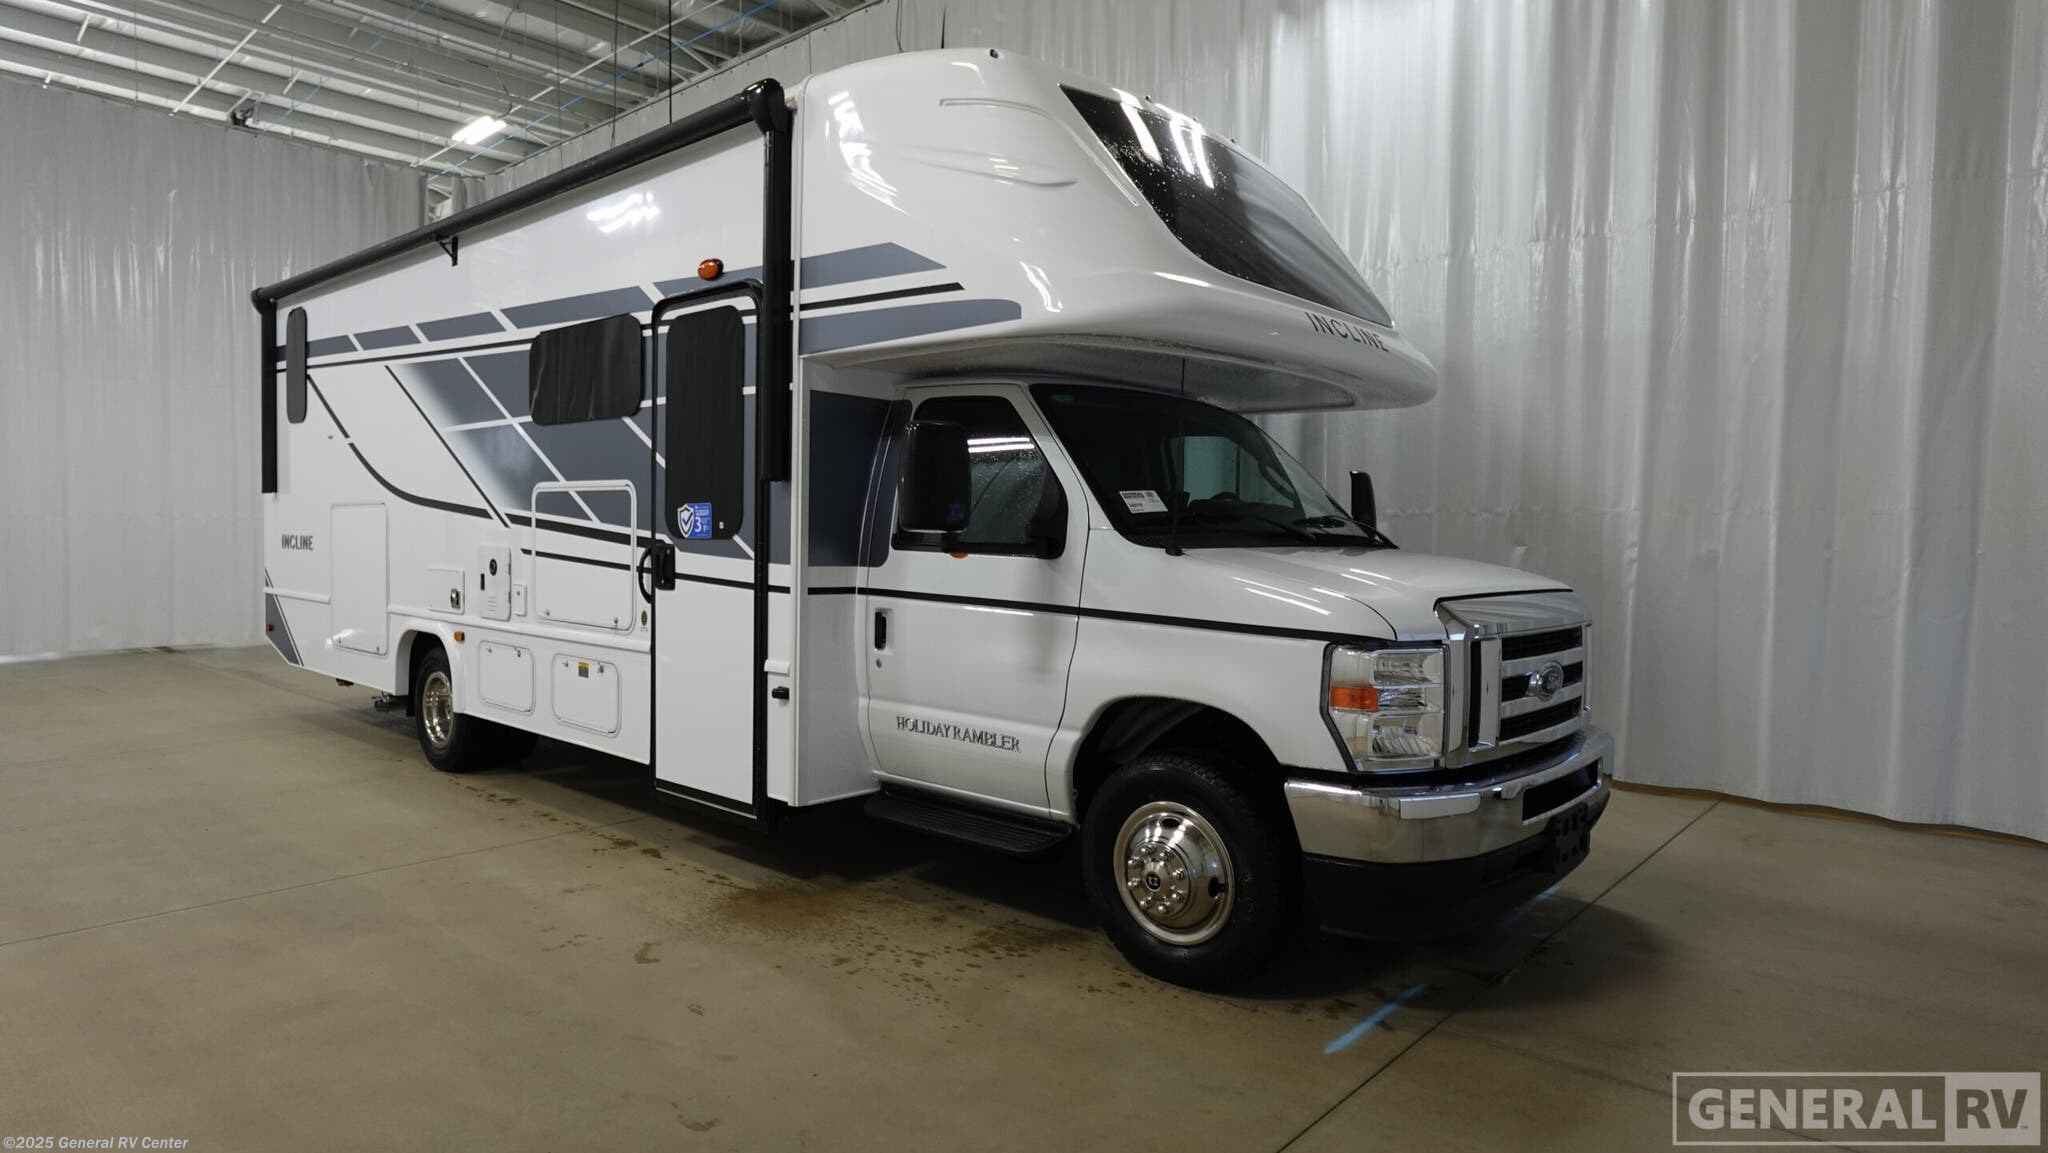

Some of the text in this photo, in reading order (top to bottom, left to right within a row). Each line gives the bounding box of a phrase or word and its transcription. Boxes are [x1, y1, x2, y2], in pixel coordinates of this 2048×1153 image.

[1305, 311, 1389, 352] INCLINE
[281, 534, 314, 551] INCLINE
[896, 716, 1021, 752] HOLIDAY RAMBLER
